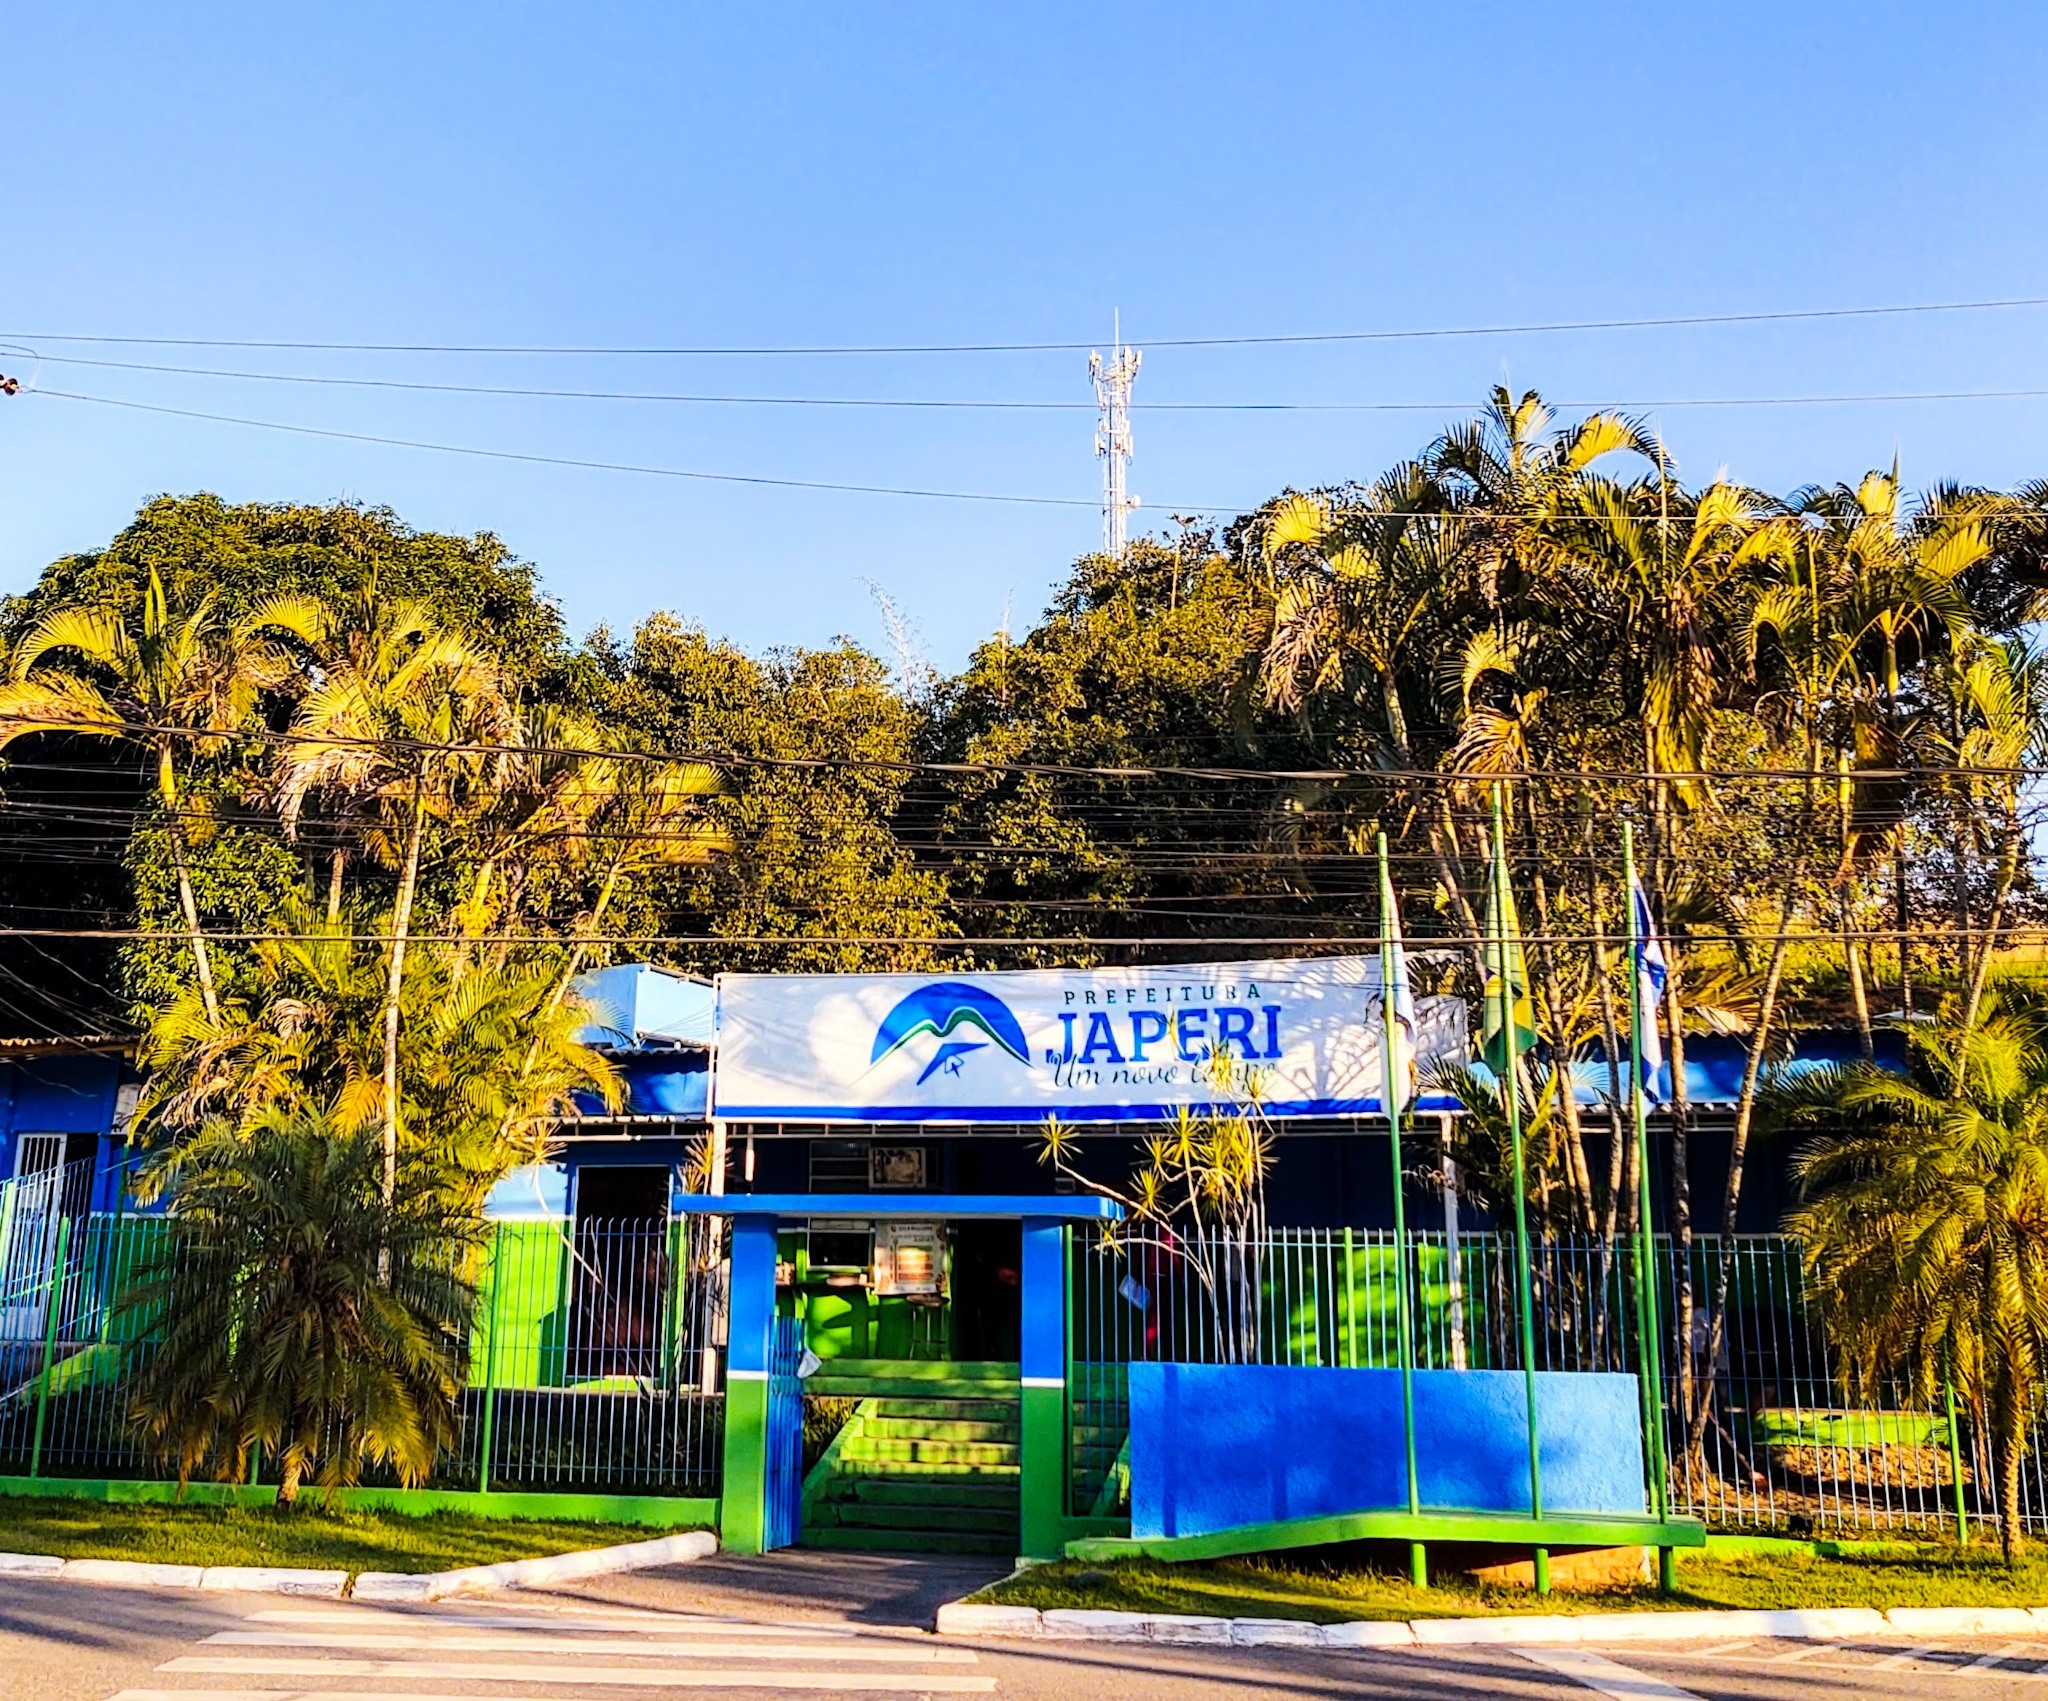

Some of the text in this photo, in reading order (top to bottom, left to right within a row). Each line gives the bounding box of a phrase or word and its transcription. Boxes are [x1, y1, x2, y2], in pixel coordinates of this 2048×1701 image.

[1064, 984, 1261, 1005] PREFEITURA
[1046, 1005, 1283, 1065] JAPERI
[1053, 1052, 1104, 1089] Um
[1111, 1065, 1180, 1086] novo
